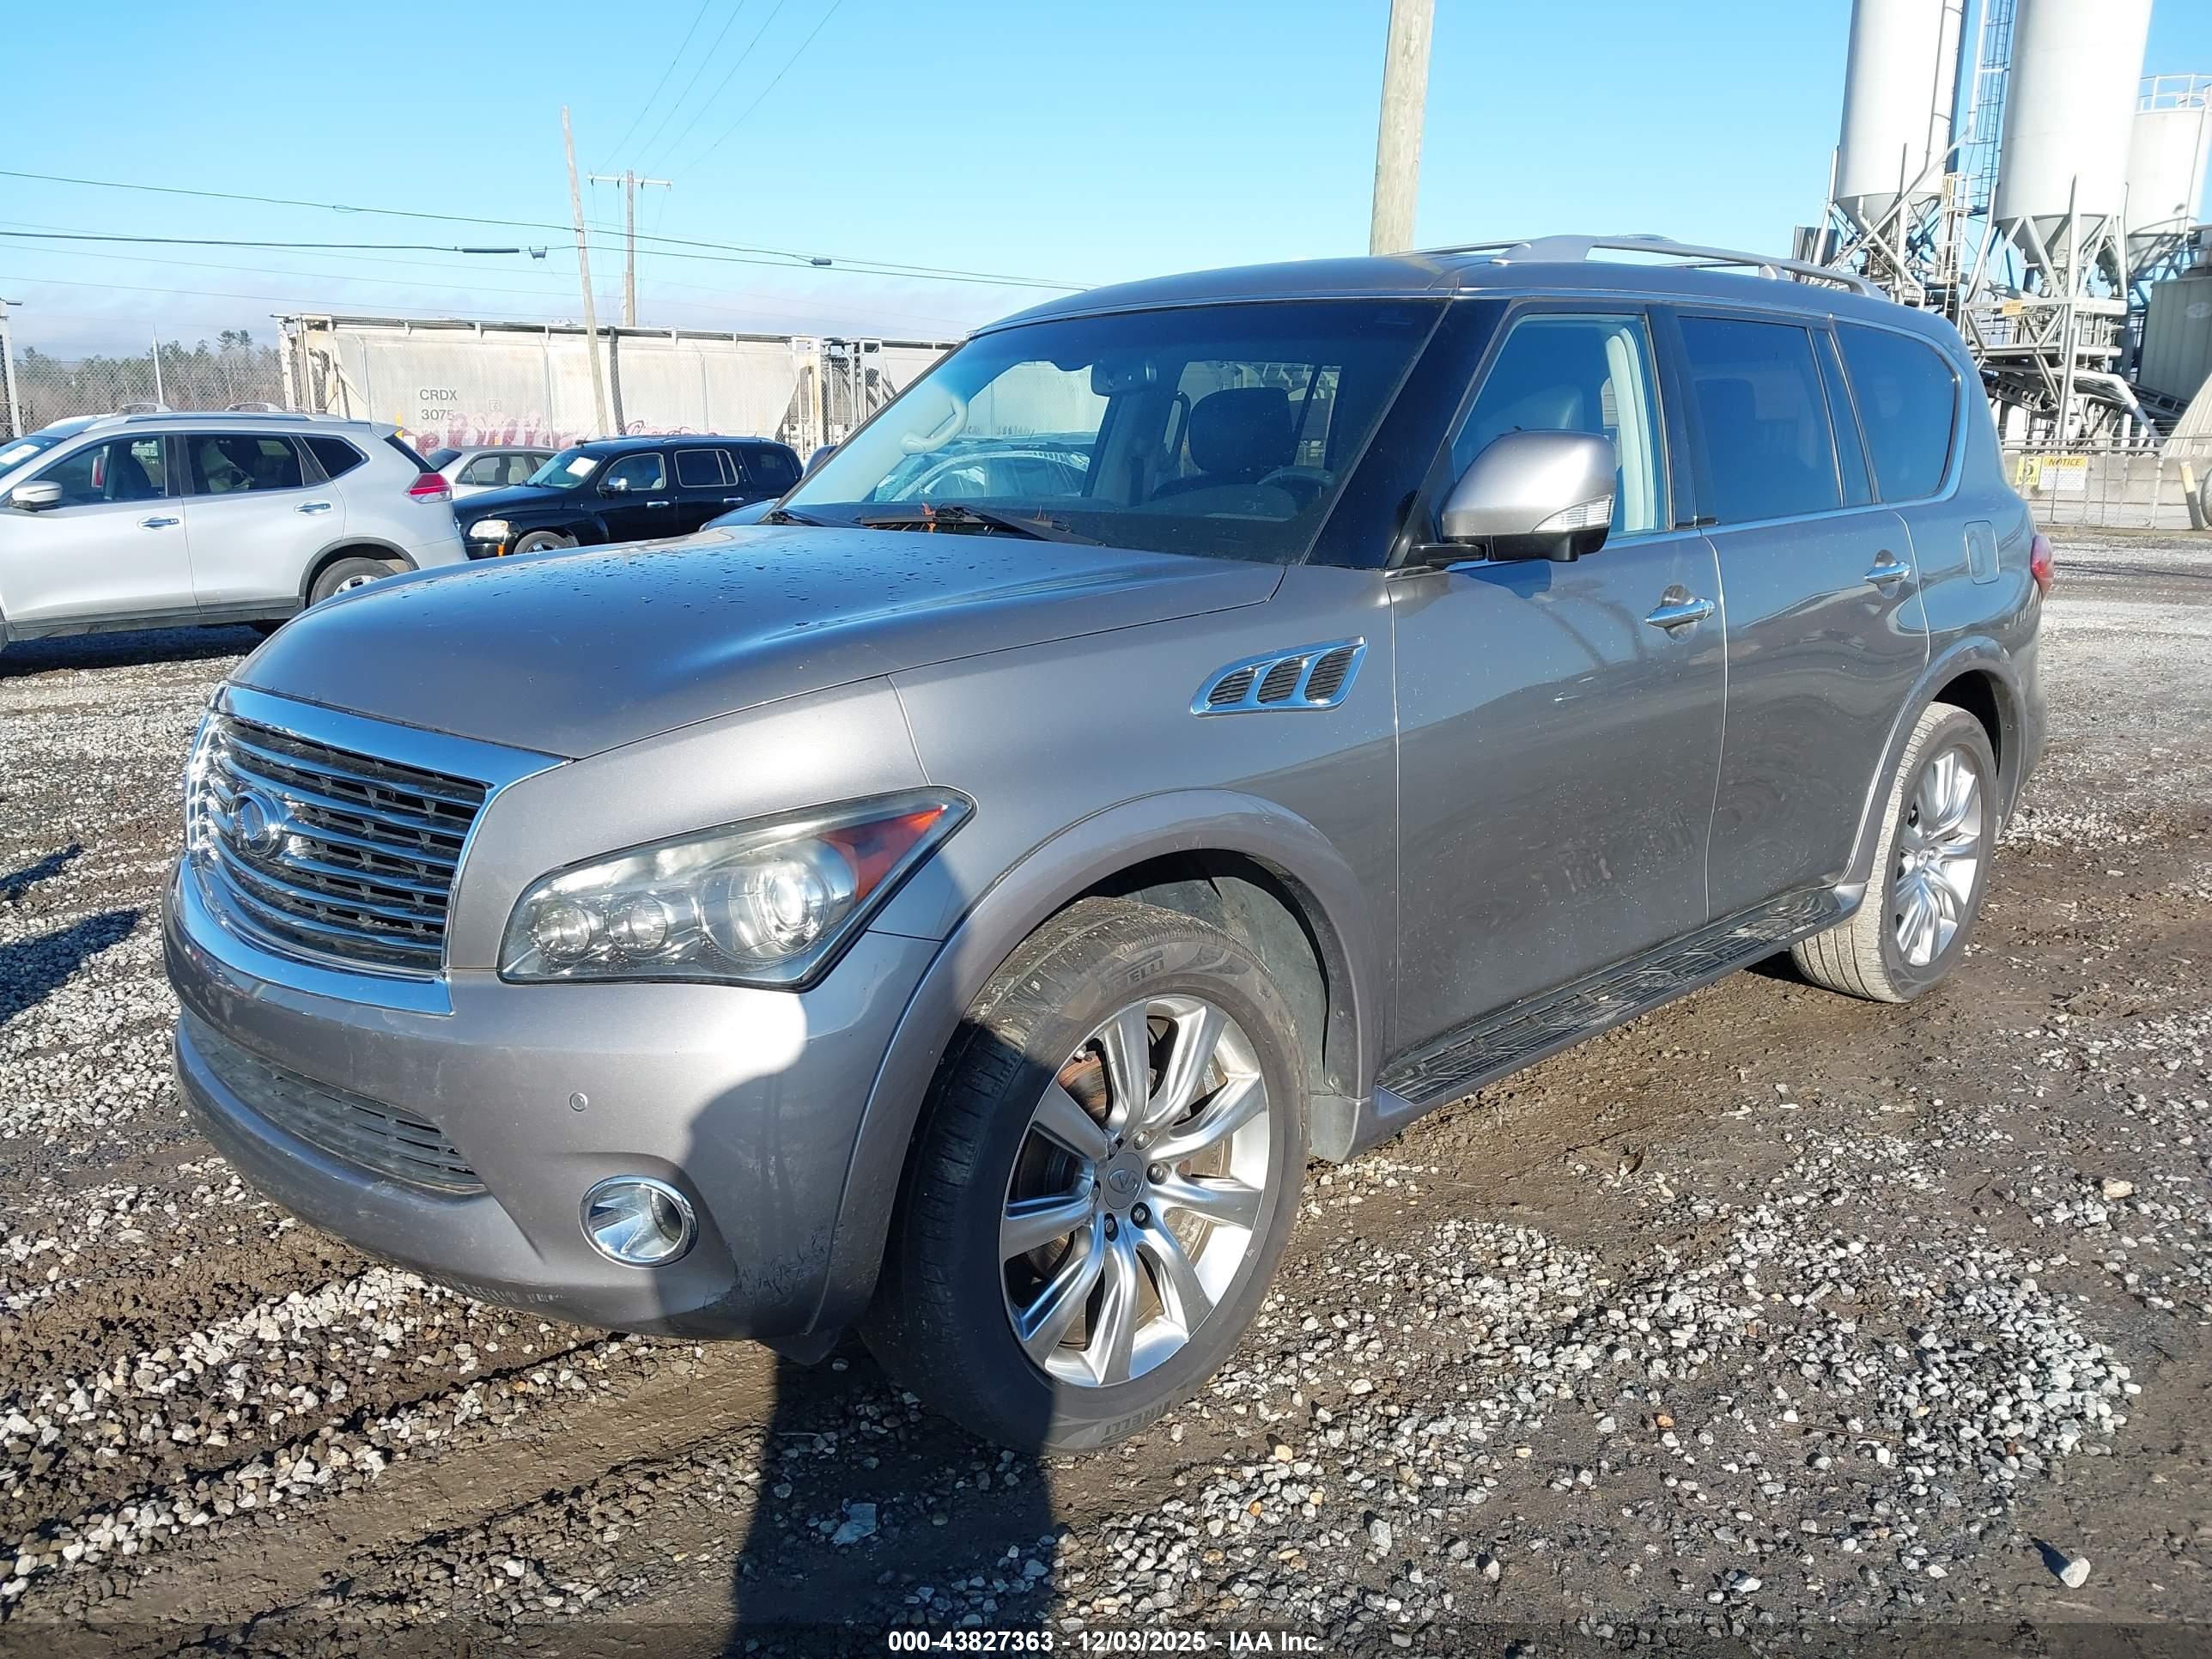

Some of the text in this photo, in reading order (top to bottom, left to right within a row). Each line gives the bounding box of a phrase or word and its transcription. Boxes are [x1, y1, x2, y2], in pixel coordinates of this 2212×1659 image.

[419, 389, 458, 401] CRDX
[2025, 458, 2035, 477] 5
[2048, 458, 2082, 467] NOTICE
